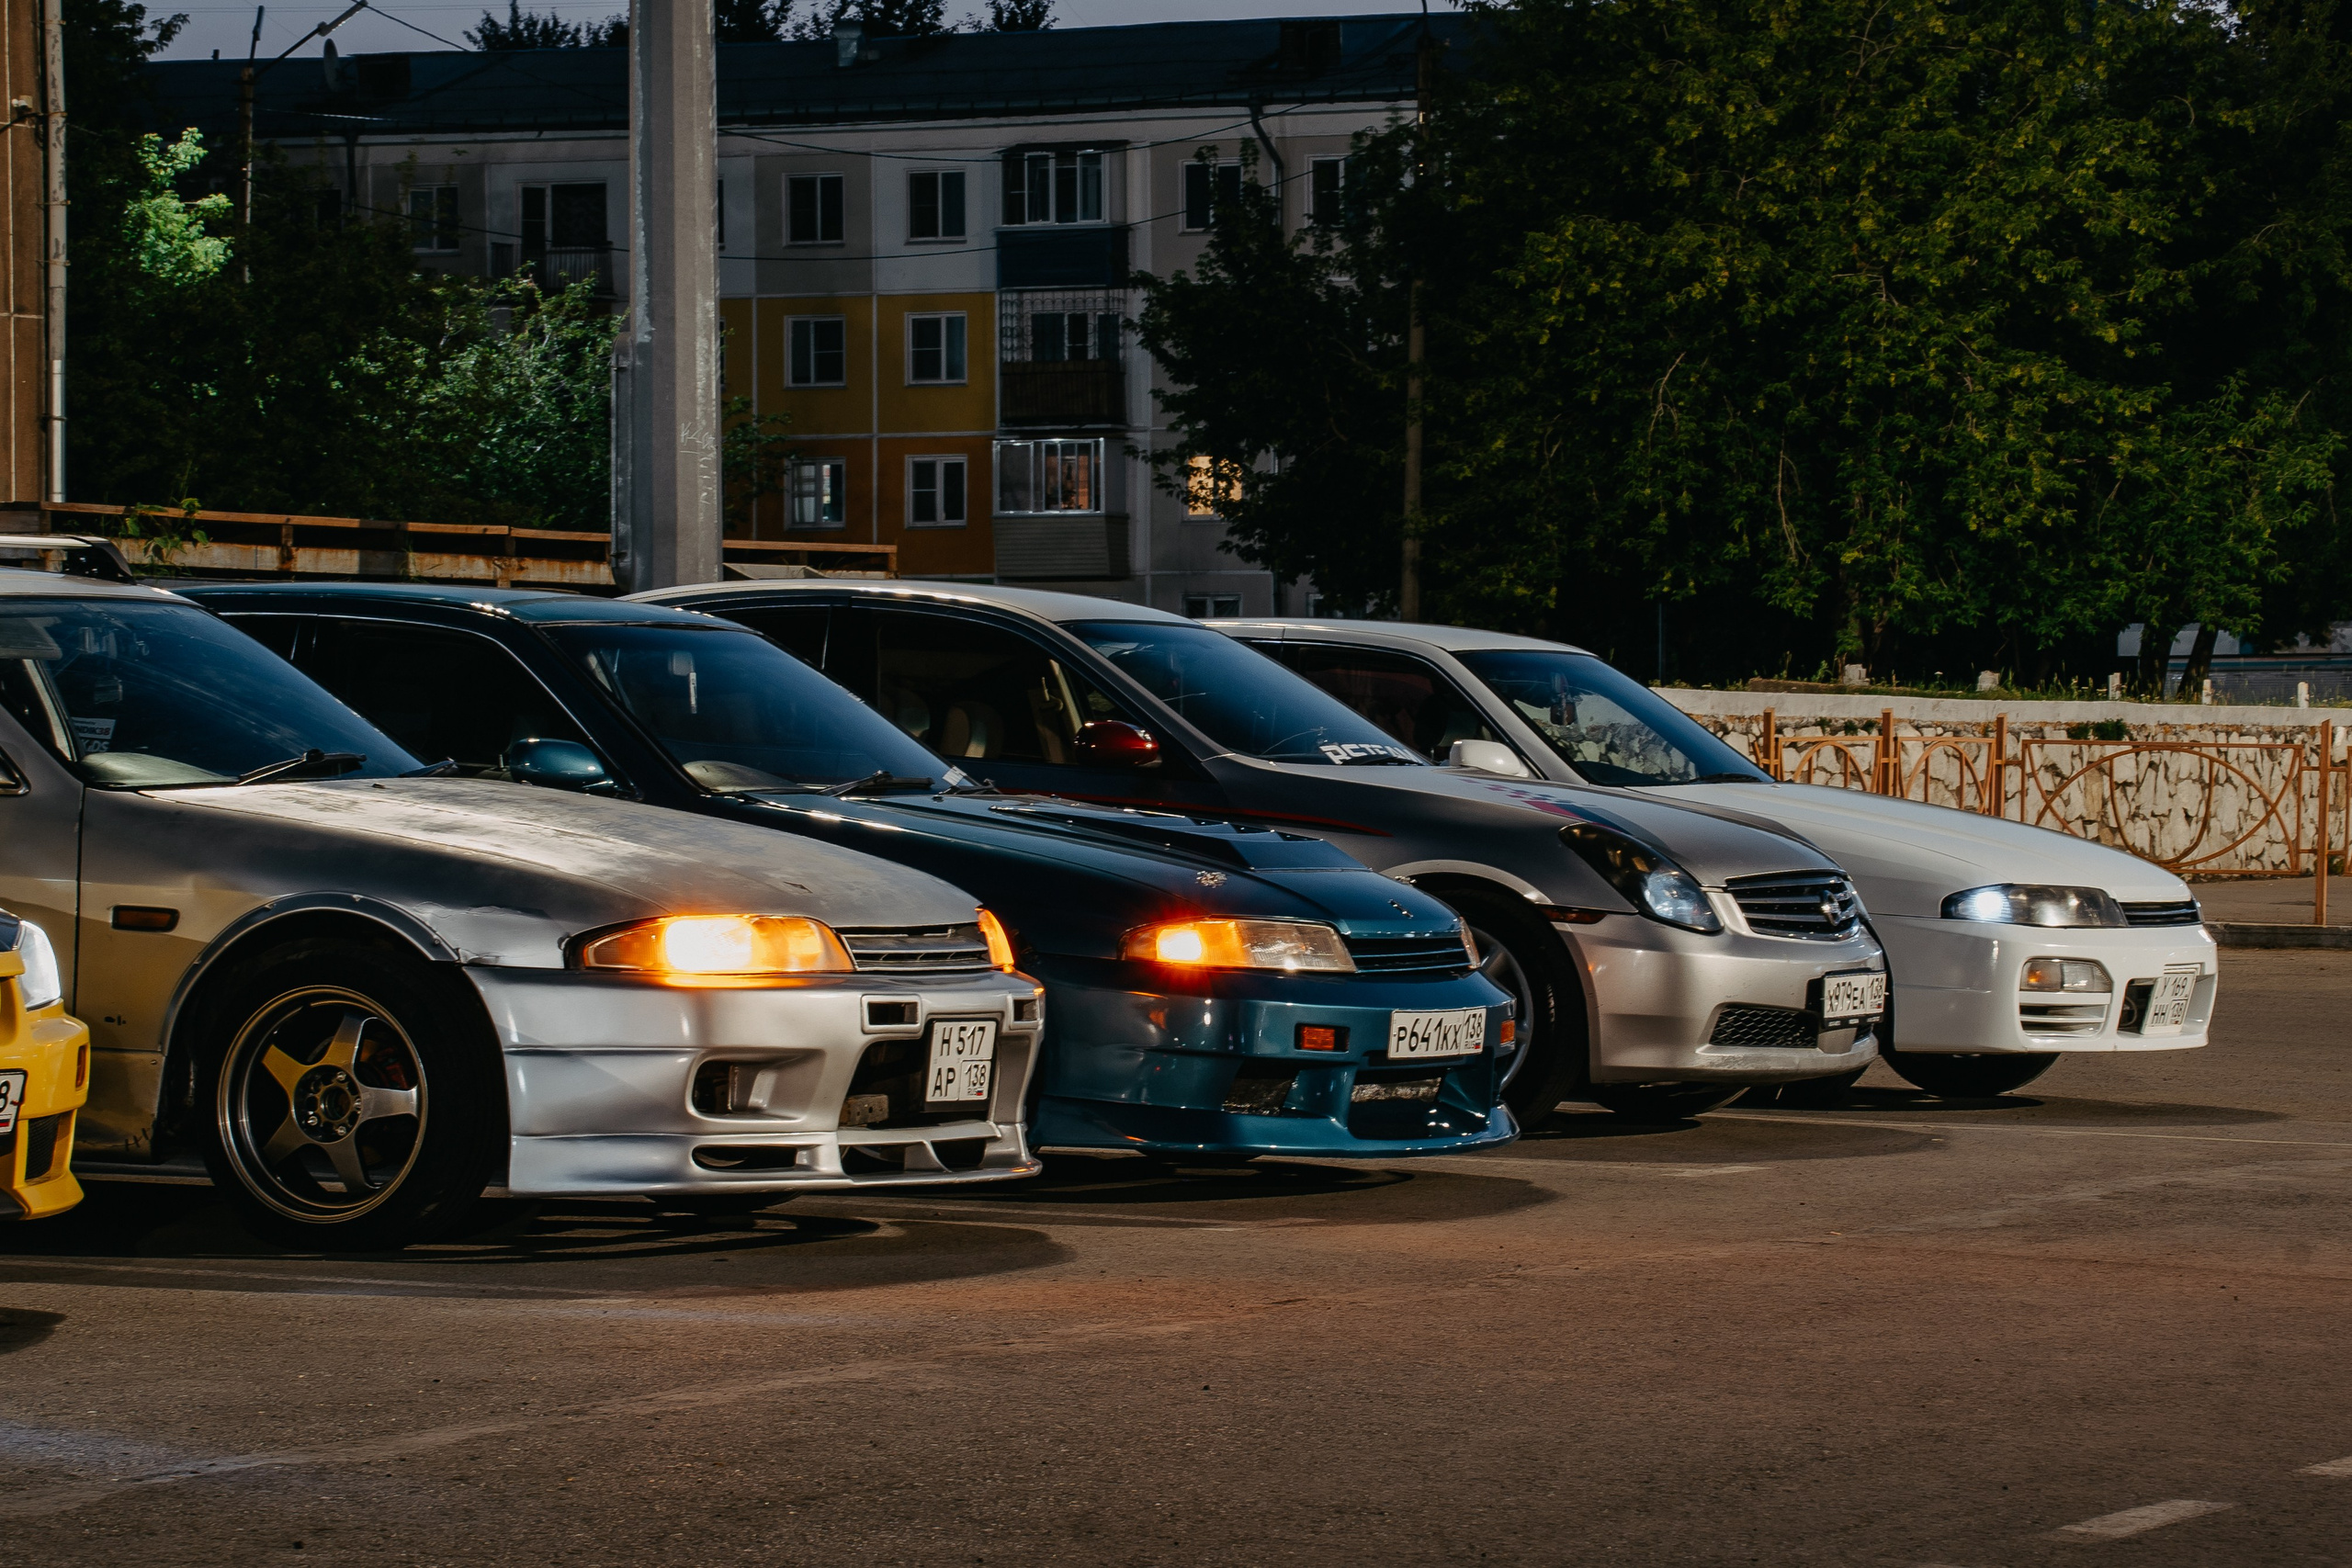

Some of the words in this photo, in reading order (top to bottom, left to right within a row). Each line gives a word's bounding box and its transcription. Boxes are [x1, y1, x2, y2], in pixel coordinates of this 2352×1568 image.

[956, 1026, 986, 1055] 517
[1396, 1018, 1462, 1053] Р641КХ
[1464, 1013, 1483, 1039] 138
[932, 1067, 956, 1097] АР
[965, 1065, 987, 1088] 138
